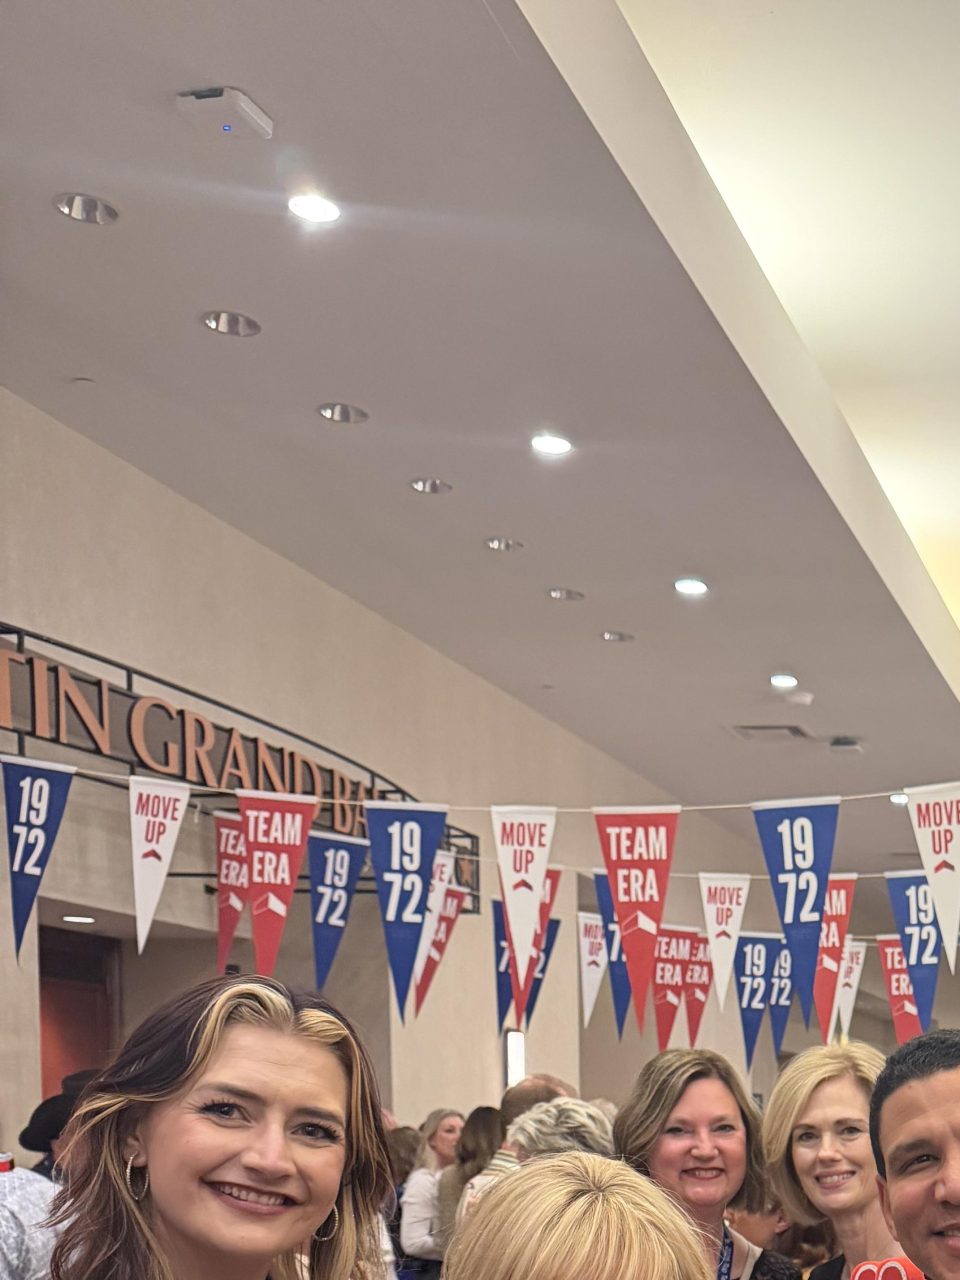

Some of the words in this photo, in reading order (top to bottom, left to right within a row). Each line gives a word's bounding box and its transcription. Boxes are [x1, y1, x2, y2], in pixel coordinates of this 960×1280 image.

[129, 695, 321, 821] GRAND
[19, 776, 50, 826] 19
[135, 791, 181, 822] MOVE
[144, 819, 167, 845] UP
[219, 828, 248, 858] TEA
[246, 809, 303, 846] TEAM
[501, 822, 547, 848] MOVE
[606, 826, 668, 861] TEAM
[776, 816, 815, 871] 19
[931, 829, 954, 855] UP
[12, 825, 46, 877] 72
[387, 820, 422, 872] 19
[513, 849, 535, 874] UP
[220, 859, 249, 889] ERA
[252, 851, 291, 886] ERA
[324, 848, 350, 888] 19
[382, 872, 423, 924] 72
[616, 868, 660, 903] ERA
[706, 886, 744, 907] MOVE
[778, 871, 820, 924] 72
[823, 888, 847, 916] AM
[315, 886, 348, 928] 72
[715, 907, 733, 926] UP
[905, 884, 935, 926] 19
[654, 936, 691, 962] TEAM
[819, 921, 840, 948] RA
[904, 925, 939, 966] 72
[655, 962, 683, 987] ERA
[743, 943, 767, 977] 19
[740, 976, 766, 1009] 72
[770, 978, 792, 1006] 72
